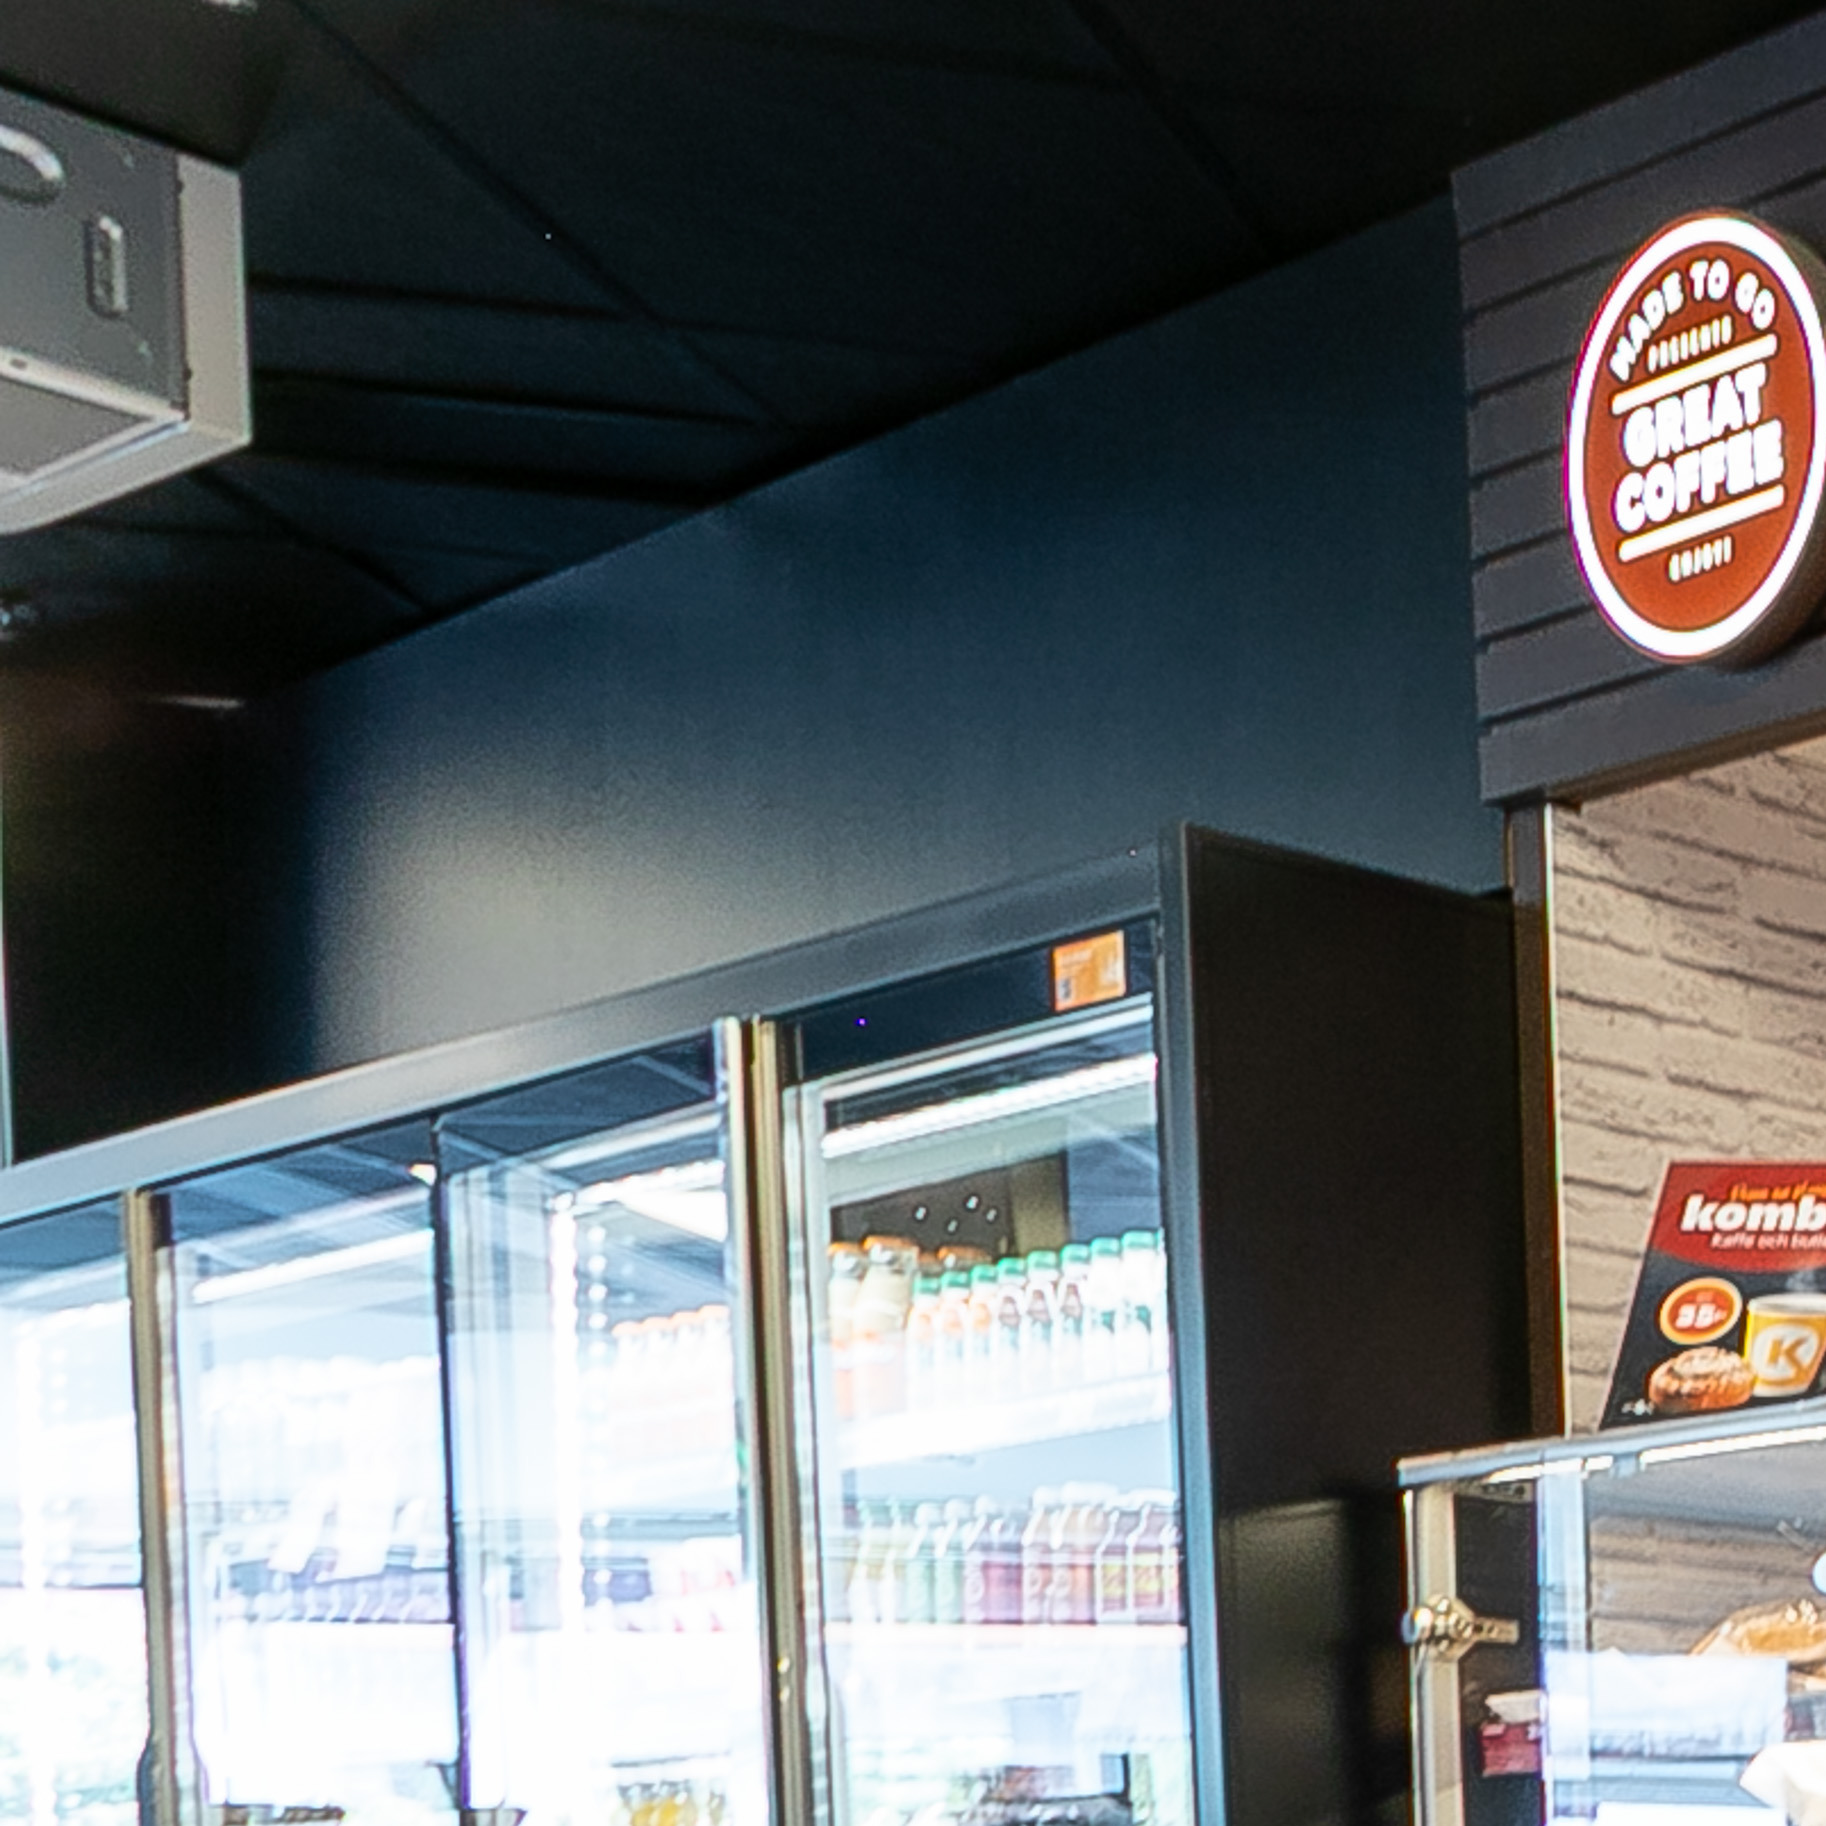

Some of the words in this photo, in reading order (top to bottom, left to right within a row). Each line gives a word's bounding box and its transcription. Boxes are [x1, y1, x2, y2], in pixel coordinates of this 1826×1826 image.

[1609, 271, 1684, 382] MADE
[1689, 259, 1730, 301] TO
[1735, 272, 1777, 329] GO
[1622, 362, 1767, 468] GREAT
[1613, 418, 1784, 533] COFFEE
[1766, 1336, 1808, 1373] K
